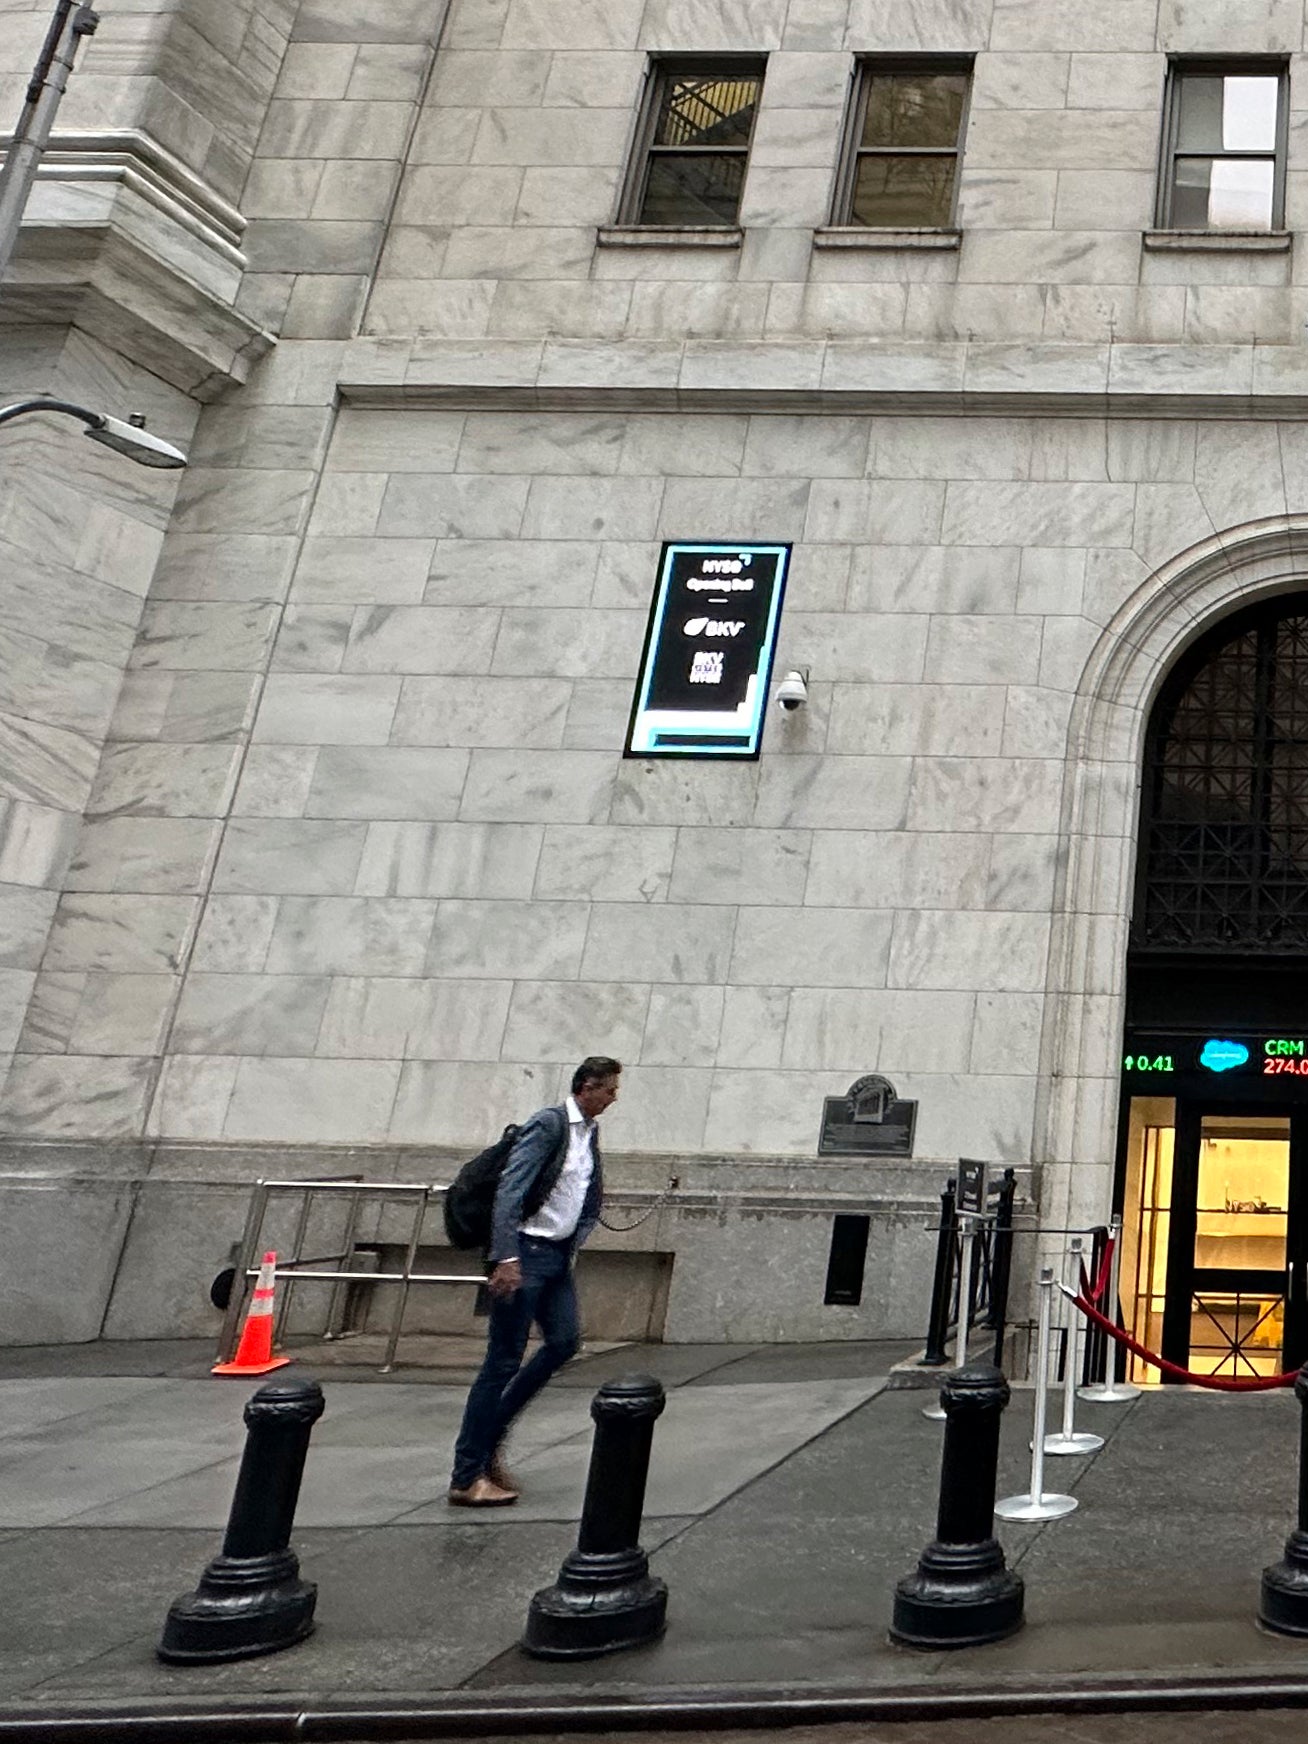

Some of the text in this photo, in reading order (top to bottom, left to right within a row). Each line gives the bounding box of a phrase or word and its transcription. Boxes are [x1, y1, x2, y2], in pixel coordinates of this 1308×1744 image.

[705, 620, 745, 637] BKV
[1264, 1040, 1305, 1056] CRM
[1137, 1055, 1174, 1072] 0.41
